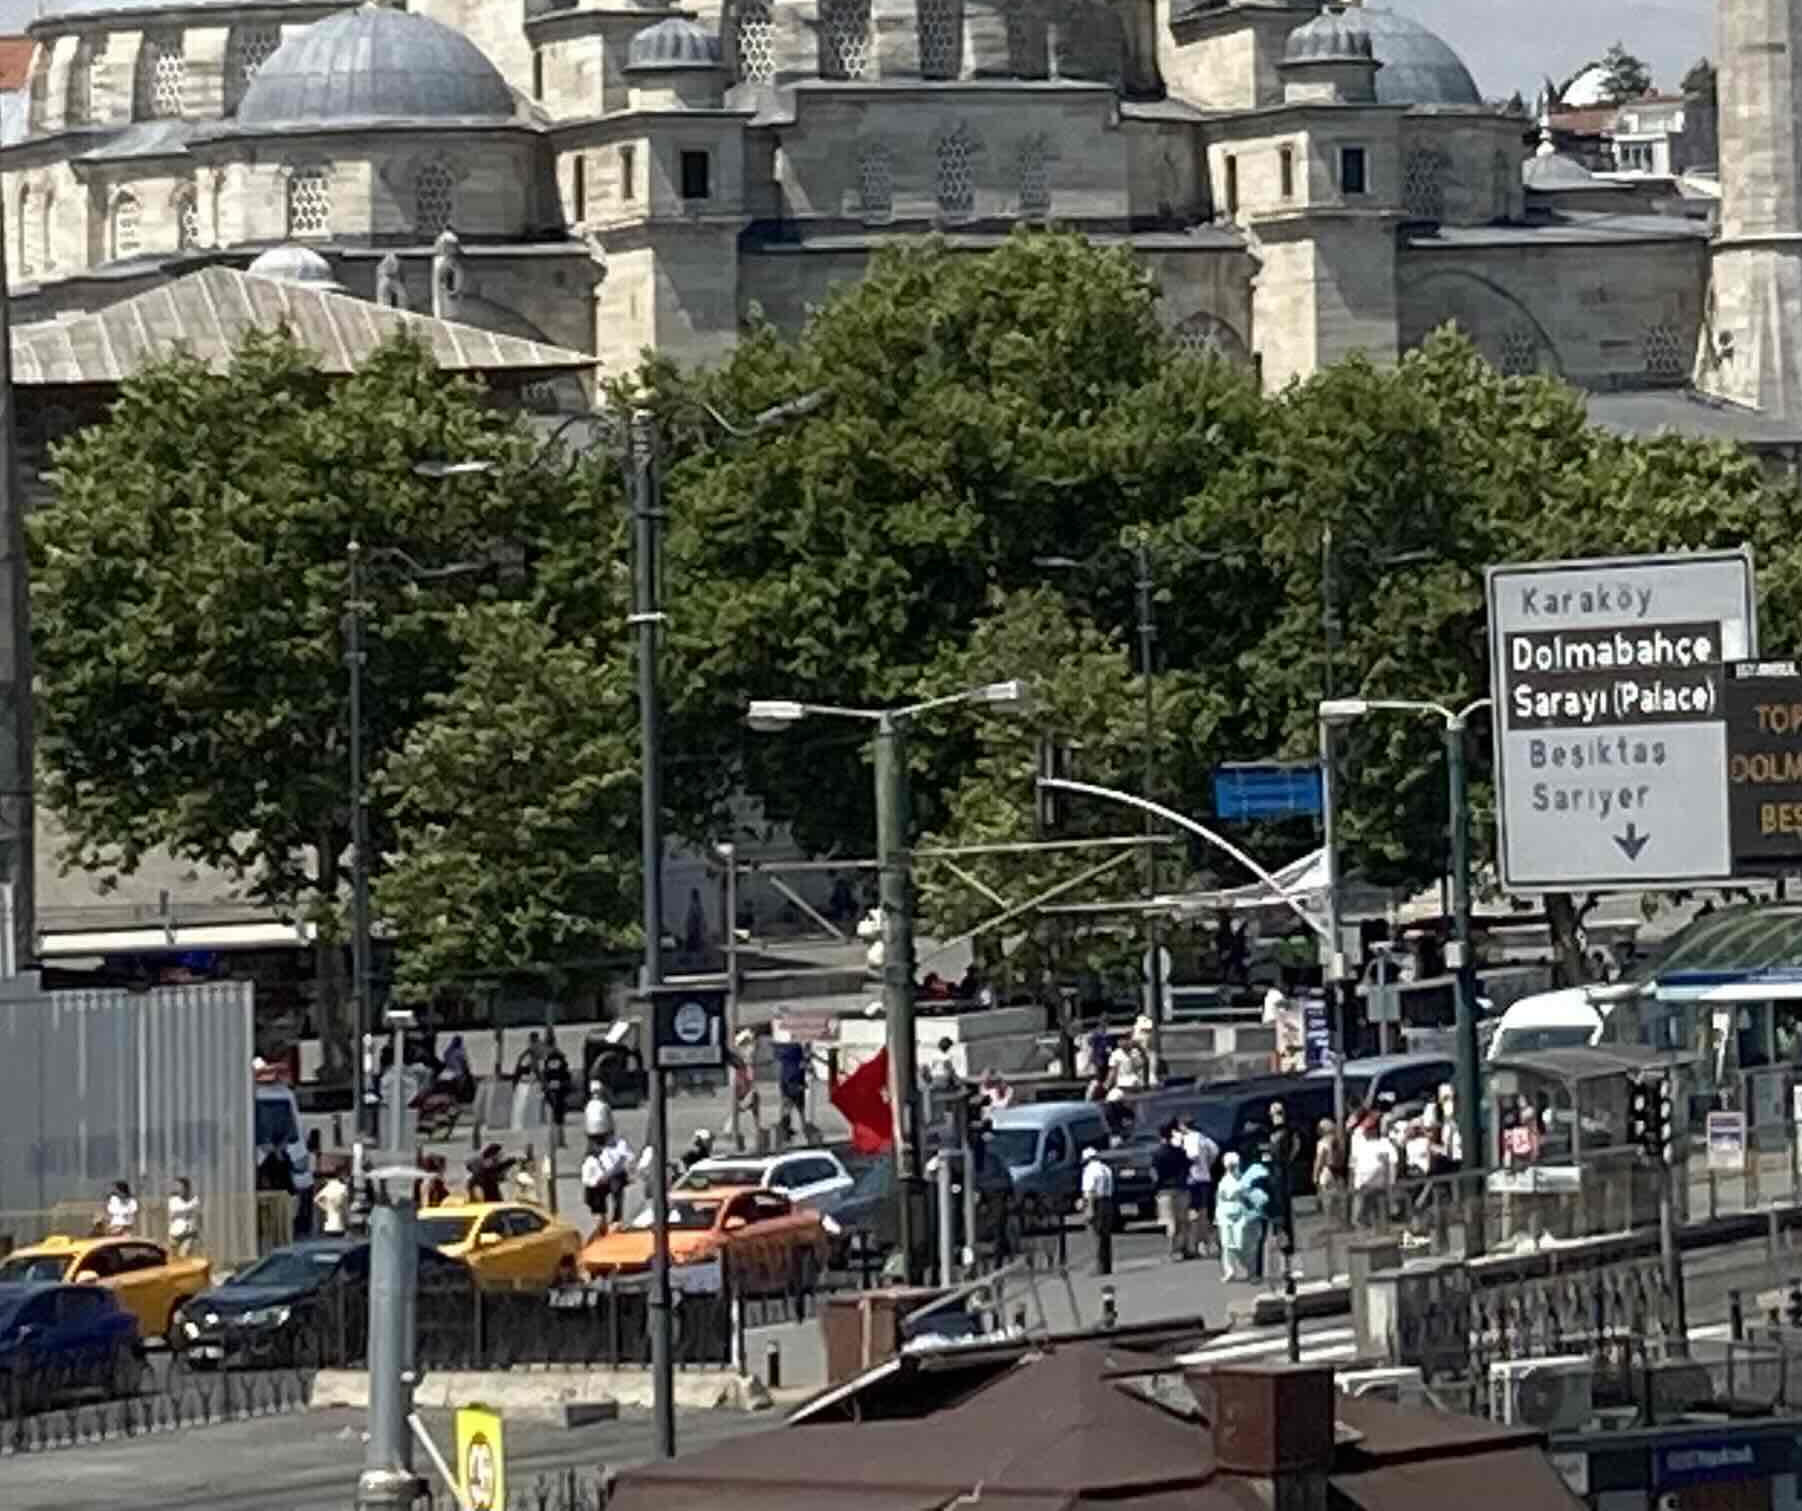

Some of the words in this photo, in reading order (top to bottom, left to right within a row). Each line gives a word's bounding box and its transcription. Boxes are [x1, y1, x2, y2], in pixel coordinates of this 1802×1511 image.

[1521, 583, 1653, 618] Karaköy
[1512, 629, 1712, 671] Dolmabahçe
[1514, 683, 1608, 723] Sarayı
[1613, 676, 1716, 719] (Palace)
[1529, 736, 1667, 769] Beşiktaş
[1532, 783, 1651, 818] Sarıyer
